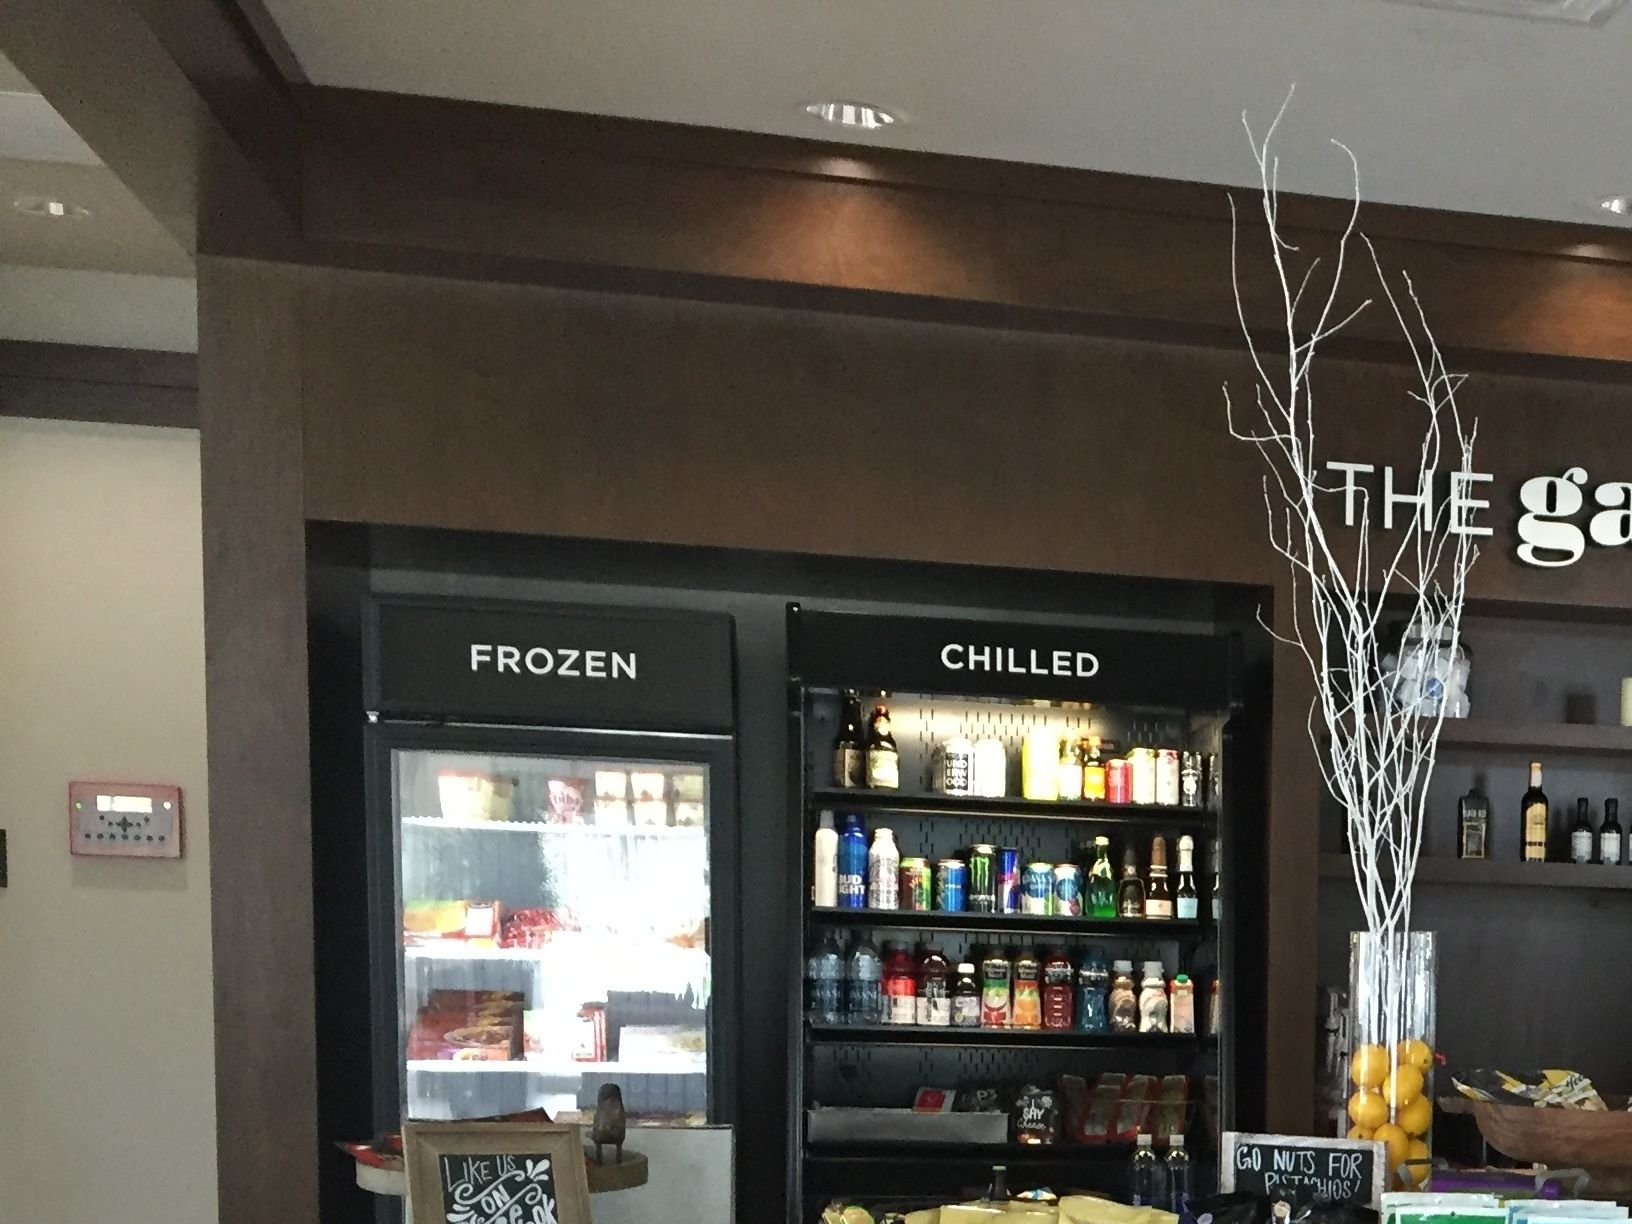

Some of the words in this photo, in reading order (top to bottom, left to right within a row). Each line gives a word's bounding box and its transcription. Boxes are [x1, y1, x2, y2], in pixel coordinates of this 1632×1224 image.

[1326, 461, 1495, 536] THE
[470, 643, 637, 680] FROZEN
[941, 643, 1100, 679] CHILLED
[1022, 1107, 1045, 1120] SAY
[443, 1156, 493, 1193] LIKE
[496, 1154, 516, 1176] US
[1236, 1146, 1262, 1172] GO
[1273, 1149, 1316, 1175] NUTS
[1328, 1152, 1362, 1180] FOR
[480, 1184, 511, 1215] ON
